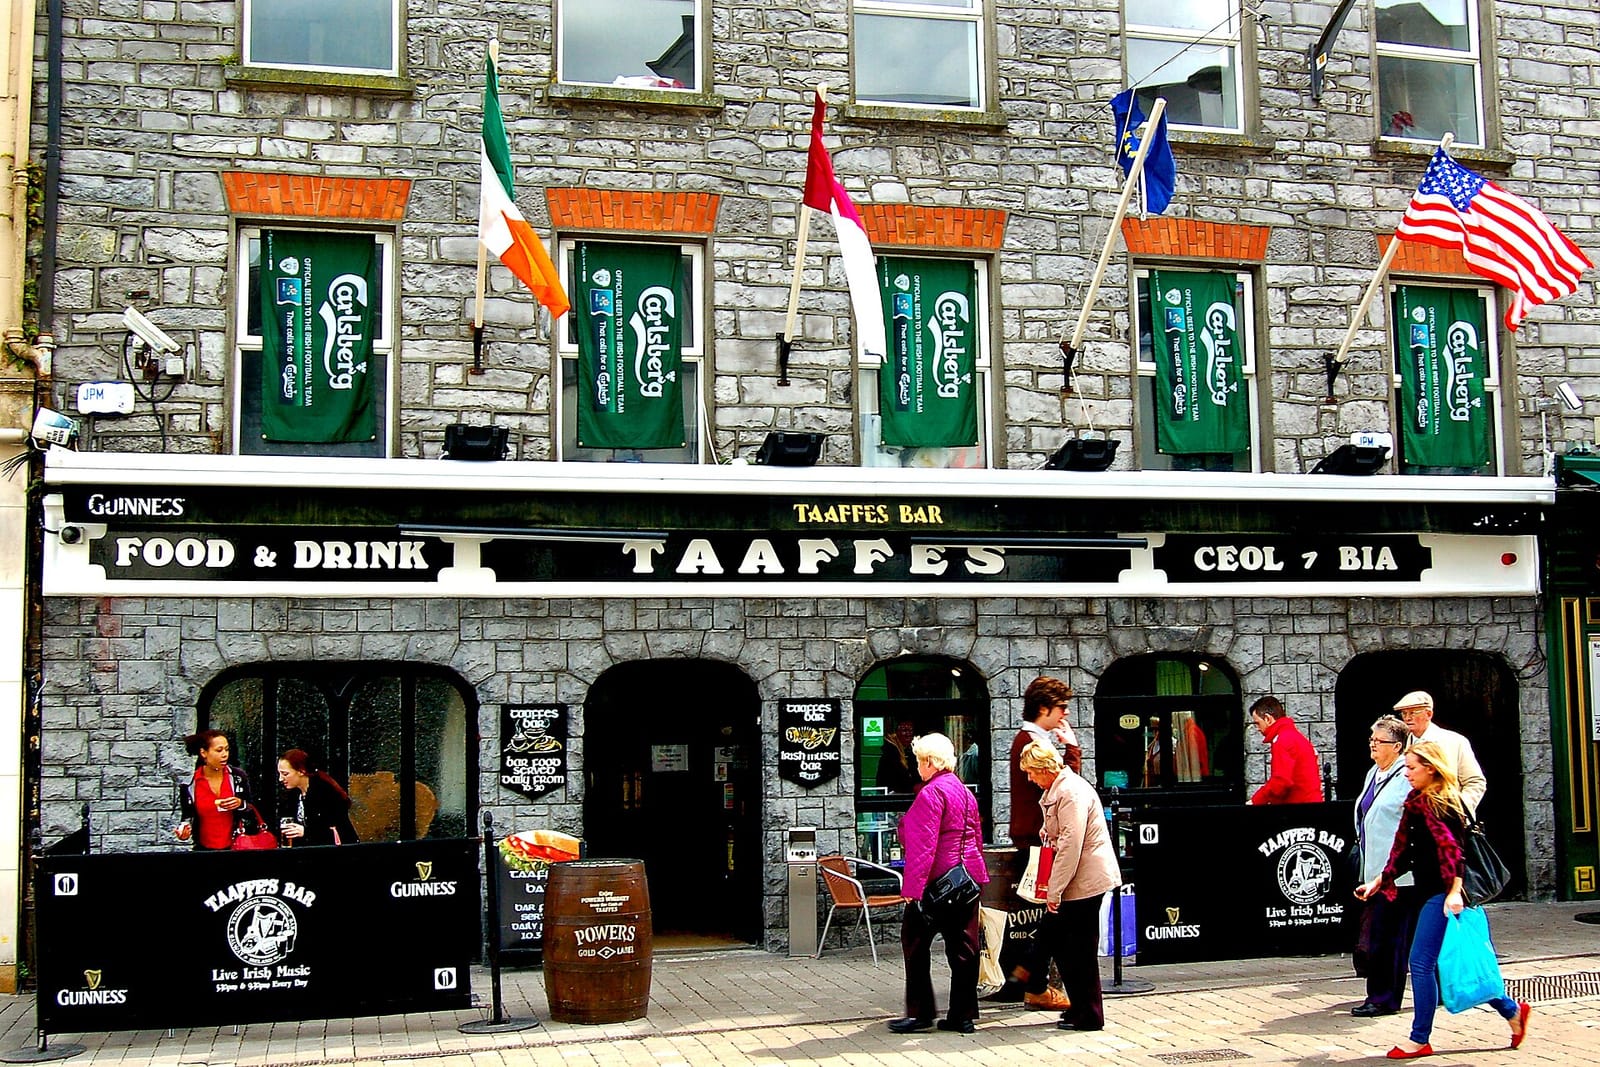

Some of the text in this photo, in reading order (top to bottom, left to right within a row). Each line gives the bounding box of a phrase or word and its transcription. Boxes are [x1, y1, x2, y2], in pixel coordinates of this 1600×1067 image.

[305, 307, 312, 316] TO
[616, 317, 623, 326] TO
[915, 321, 921, 329] TO
[318, 274, 367, 389] Carlsberg
[1187, 333, 1194, 341] TO
[629, 286, 675, 398] Carlsberg
[927, 292, 969, 398] Carlsberg
[1200, 302, 1235, 406] Carlsberg
[1431, 349, 1436, 357] TO
[1442, 321, 1478, 421] Carlsberg
[83, 388, 104, 400] JPM
[1190, 371, 1198, 401] FOOTBALL
[793, 503, 944, 524] TAAFFES BAR
[114, 537, 428, 570] FOOD & DRINK
[622, 538, 1006, 576] TAAFFES
[1194, 546, 1284, 572] CEOL
[1338, 546, 1398, 571] BIA
[1318, 830, 1345, 853] BAR
[282, 882, 316, 908] BAR
[390, 881, 458, 898] GUINNESS
[1266, 903, 1344, 918] Live Irish Music
[574, 924, 636, 946] POWERS
[1010, 931, 1027, 939] GOLD
[1146, 924, 1200, 940] GUINNESS
[578, 949, 596, 957] GOLD
[616, 946, 634, 954] LABEL
[212, 964, 311, 981] Live Irish Music
[294, 979, 308, 987] Day
[57, 989, 128, 1006] GUINNESS
